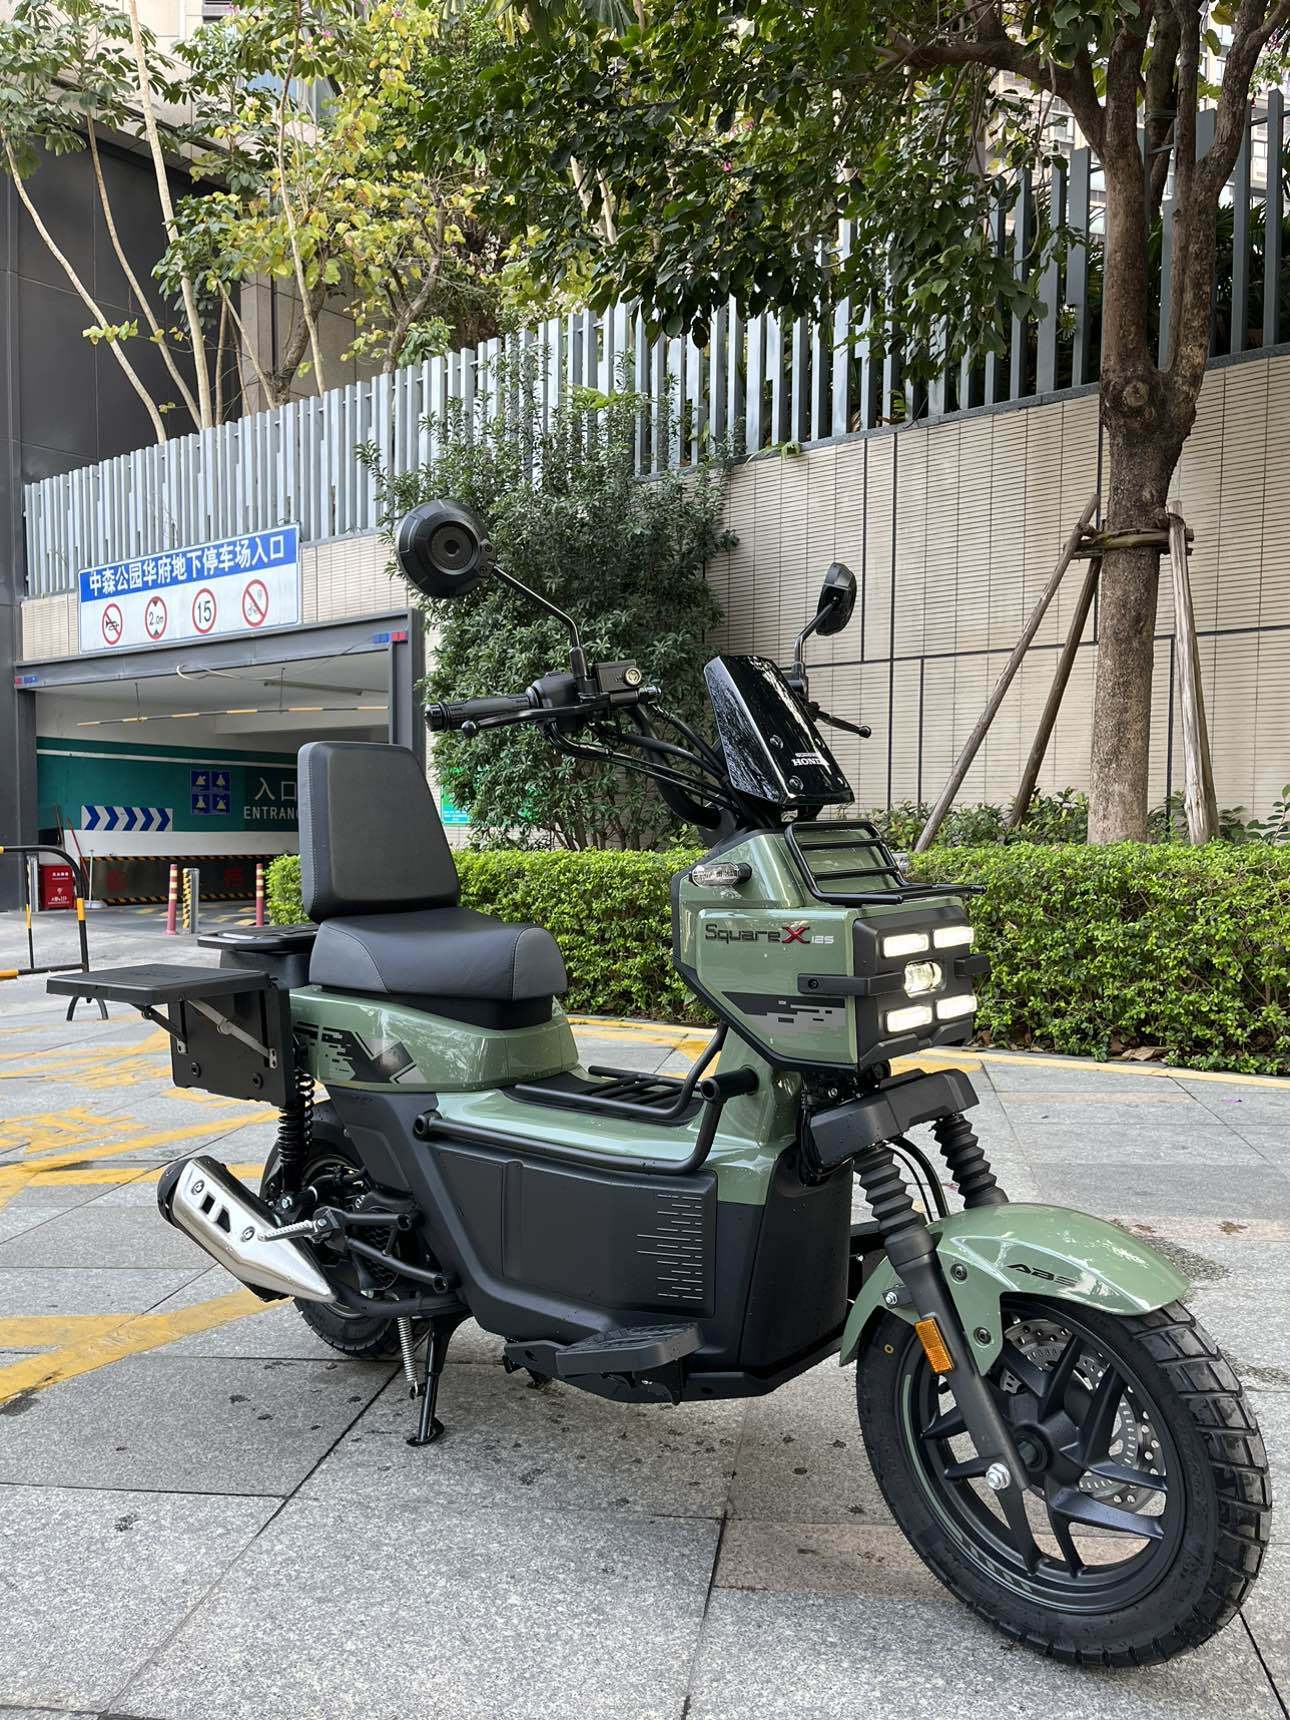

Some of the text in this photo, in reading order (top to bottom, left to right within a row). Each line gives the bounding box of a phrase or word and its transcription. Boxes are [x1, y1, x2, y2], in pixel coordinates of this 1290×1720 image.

[89, 534, 284, 596] 中森公园华府地下停车场入口
[198, 600, 212, 623] 15
[254, 777, 297, 801] 入口
[243, 806, 299, 820] ENTRAN
[1007, 1263, 1078, 1288] ABS
